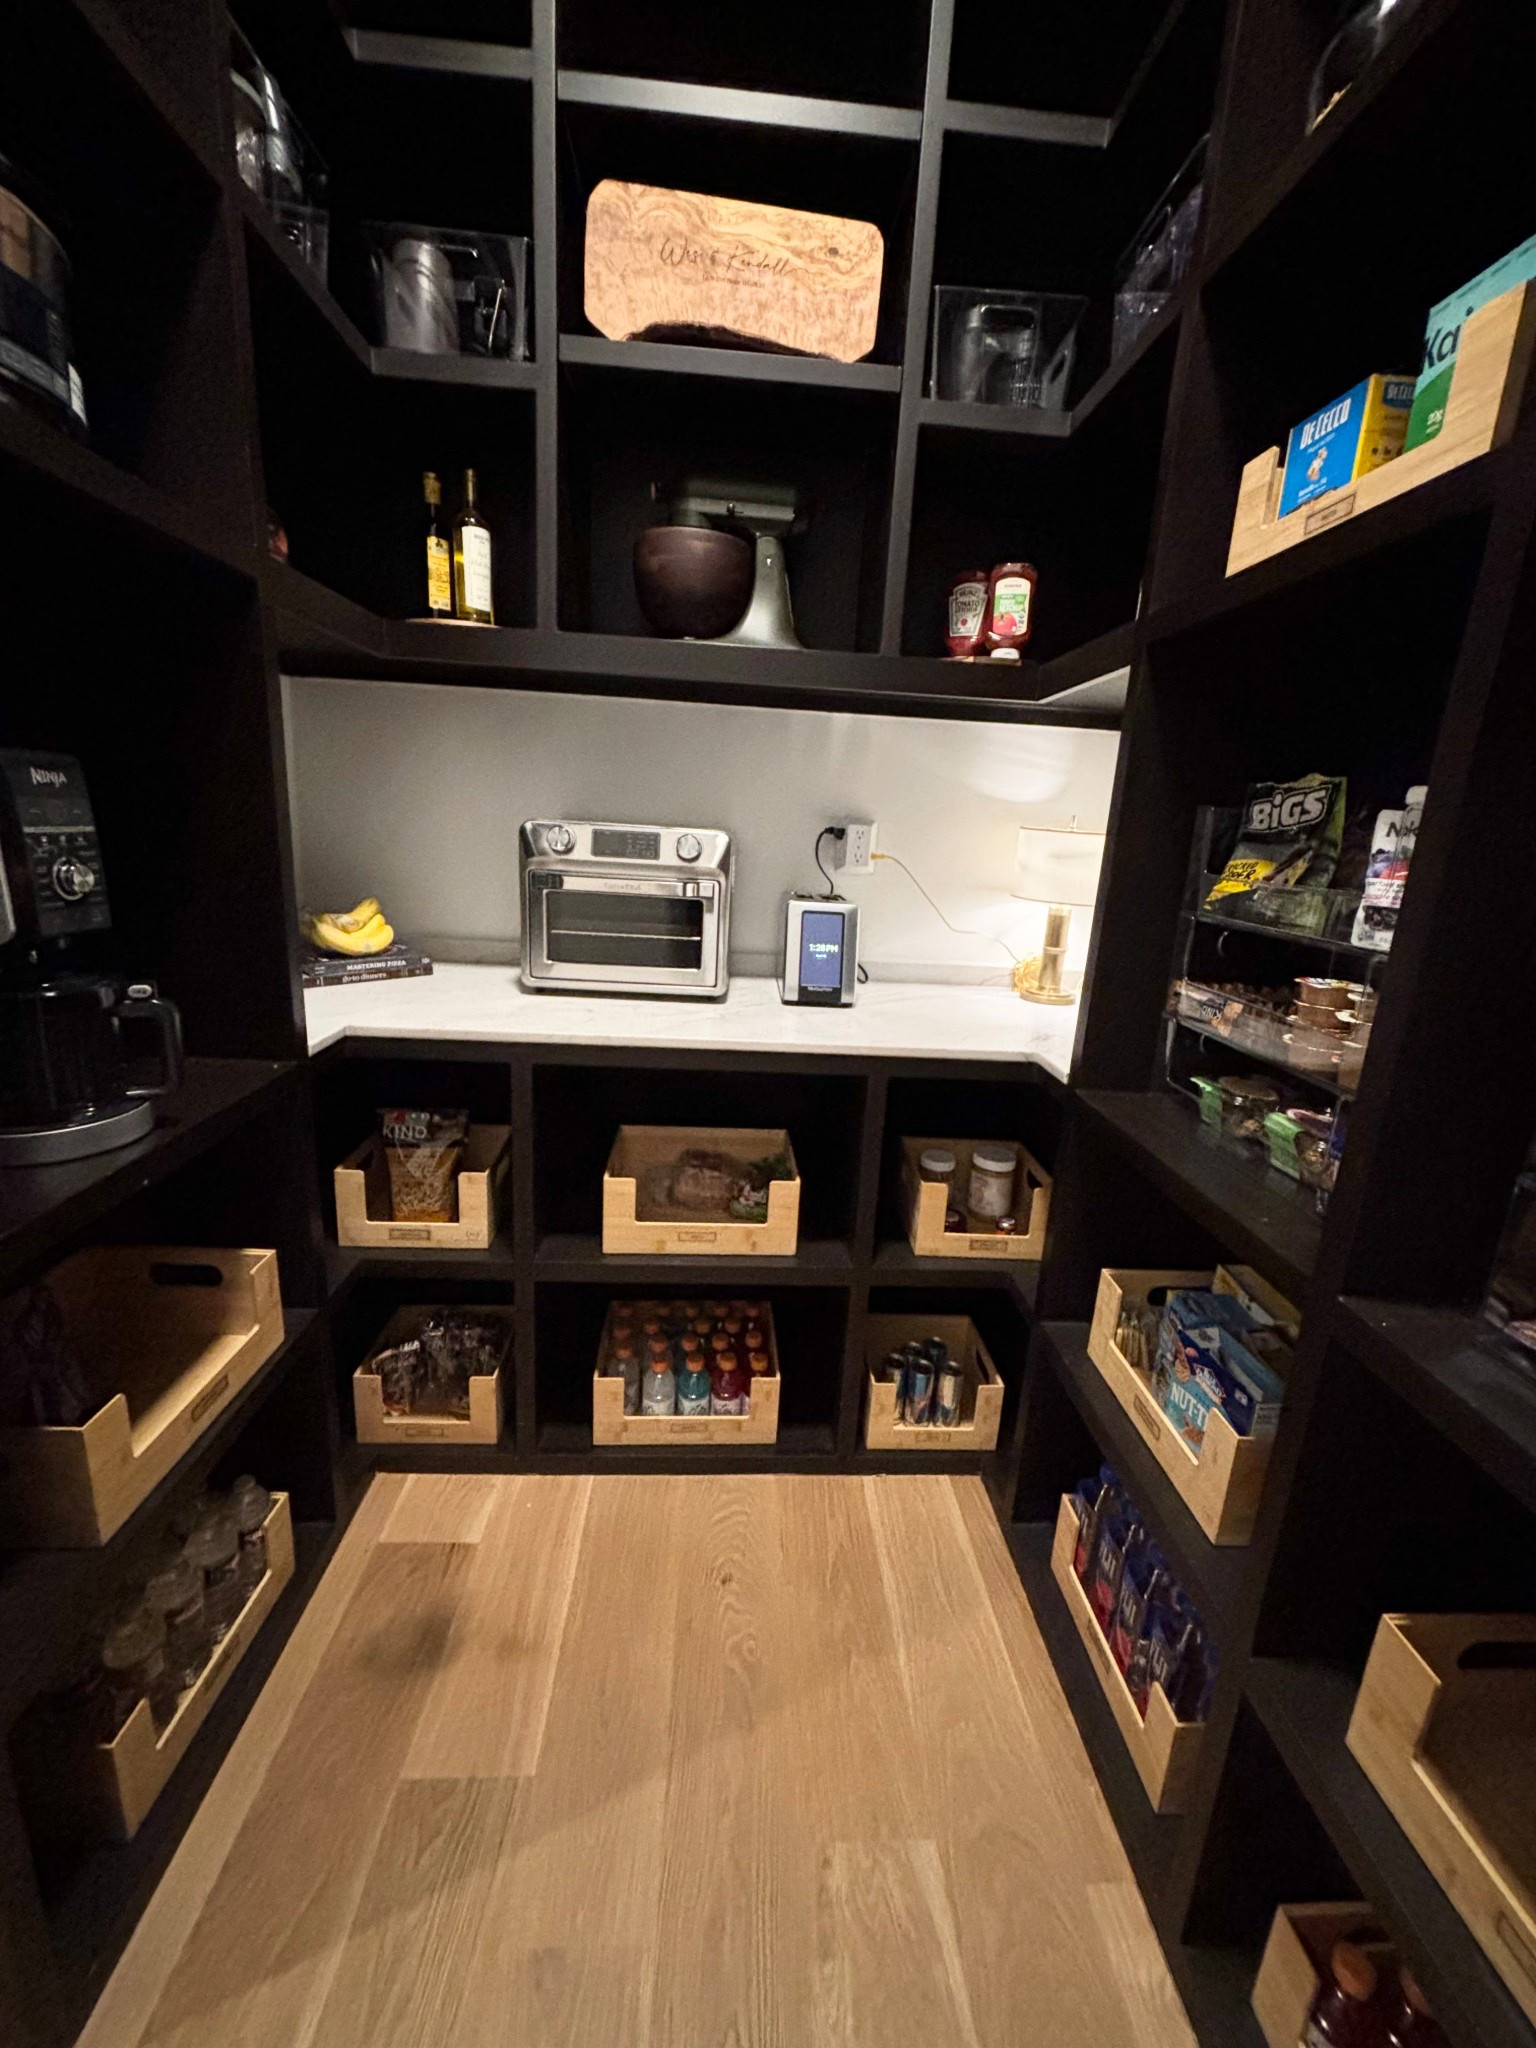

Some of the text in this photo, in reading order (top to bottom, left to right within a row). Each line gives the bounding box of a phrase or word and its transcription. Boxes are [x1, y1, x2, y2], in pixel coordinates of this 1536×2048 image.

[1300, 420, 1317, 450] DE
[1314, 397, 1352, 440] CECCO
[30, 766, 68, 788] NINJA
[346, 959, 407, 971] MASTERING PIZZA
[382, 1125, 428, 1140] KIND
